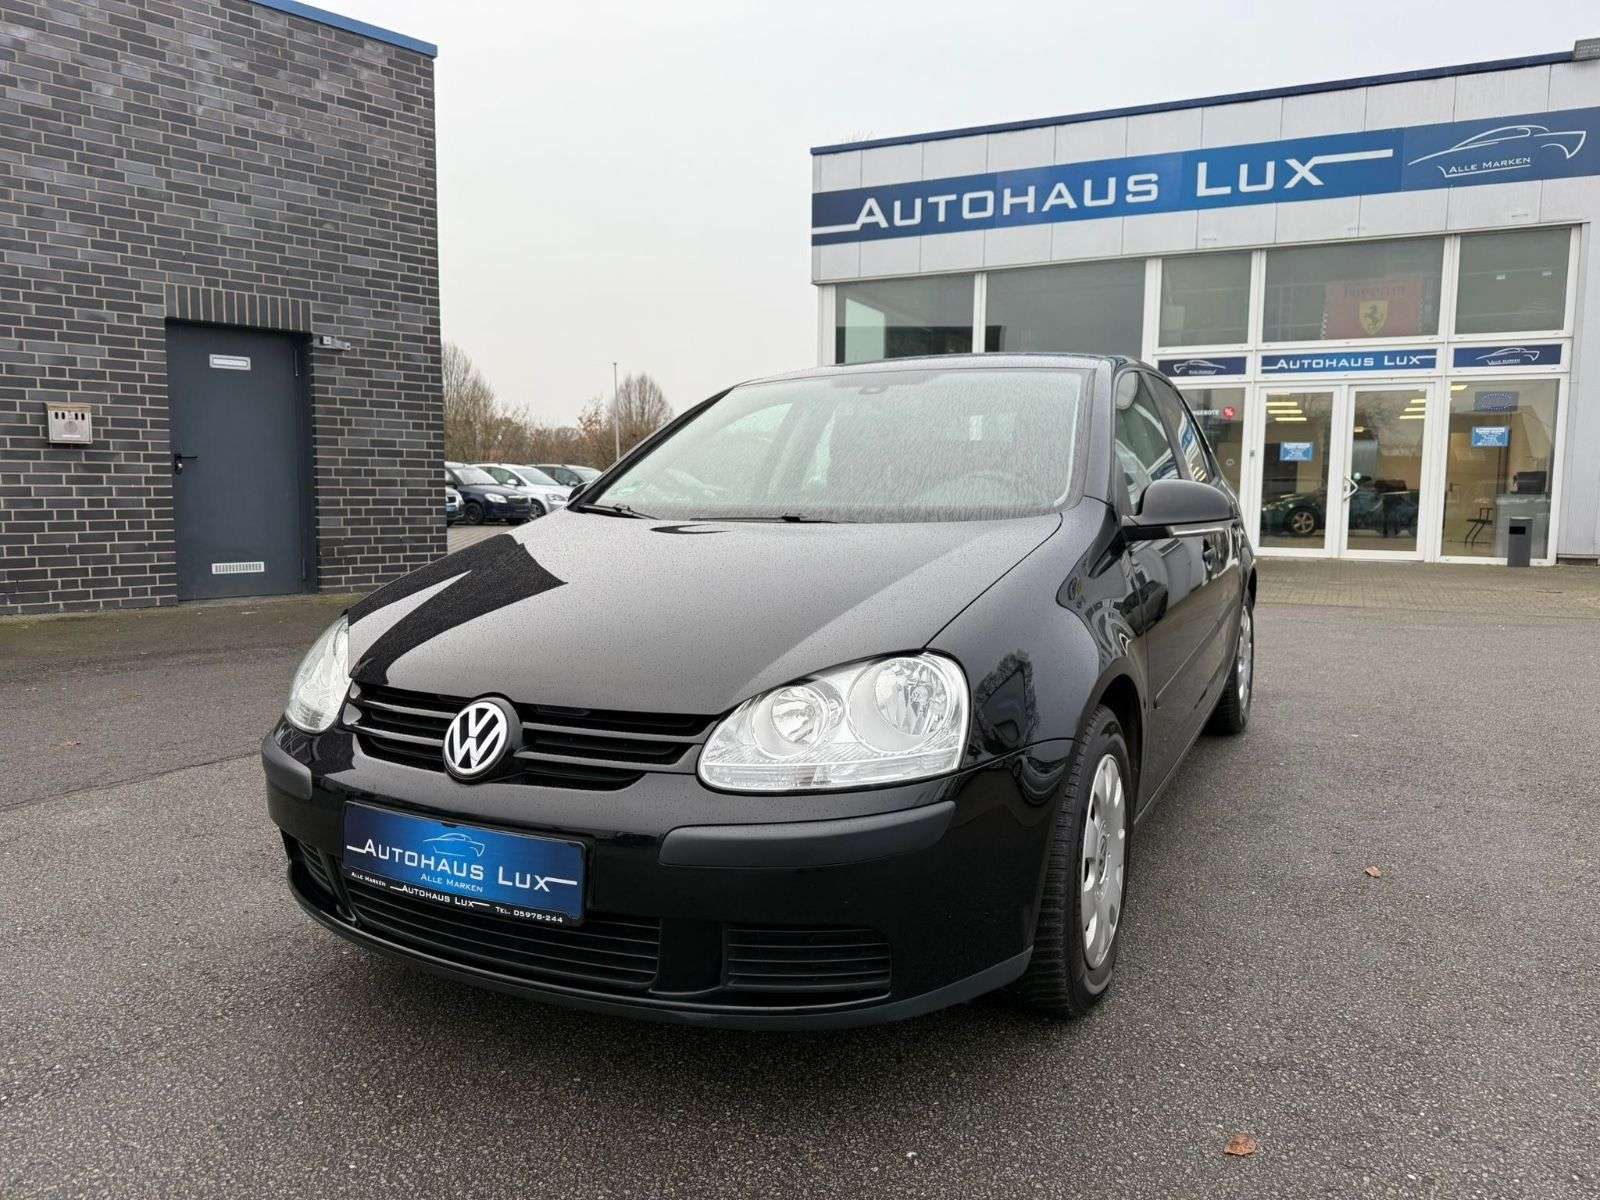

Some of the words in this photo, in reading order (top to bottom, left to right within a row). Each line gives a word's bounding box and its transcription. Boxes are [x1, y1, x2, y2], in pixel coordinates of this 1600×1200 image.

[1449, 165, 1478, 174] ALLE
[1482, 156, 1531, 168] MARKEN
[857, 173, 1159, 229] AUTOHAUS
[1197, 156, 1325, 197] LUX
[1276, 357, 1374, 369] AUTOHAUS
[1384, 355, 1420, 366] LUX
[363, 838, 484, 881] AUTOHAUS
[498, 865, 550, 893] LUX
[351, 871, 364, 880] ALLE
[420, 873, 443, 885] ALLE
[446, 879, 483, 893] MARKEN
[402, 885, 450, 903] AUTOHAUS
[454, 896, 475, 908] LUX
[495, 906, 511, 915] TEL.
